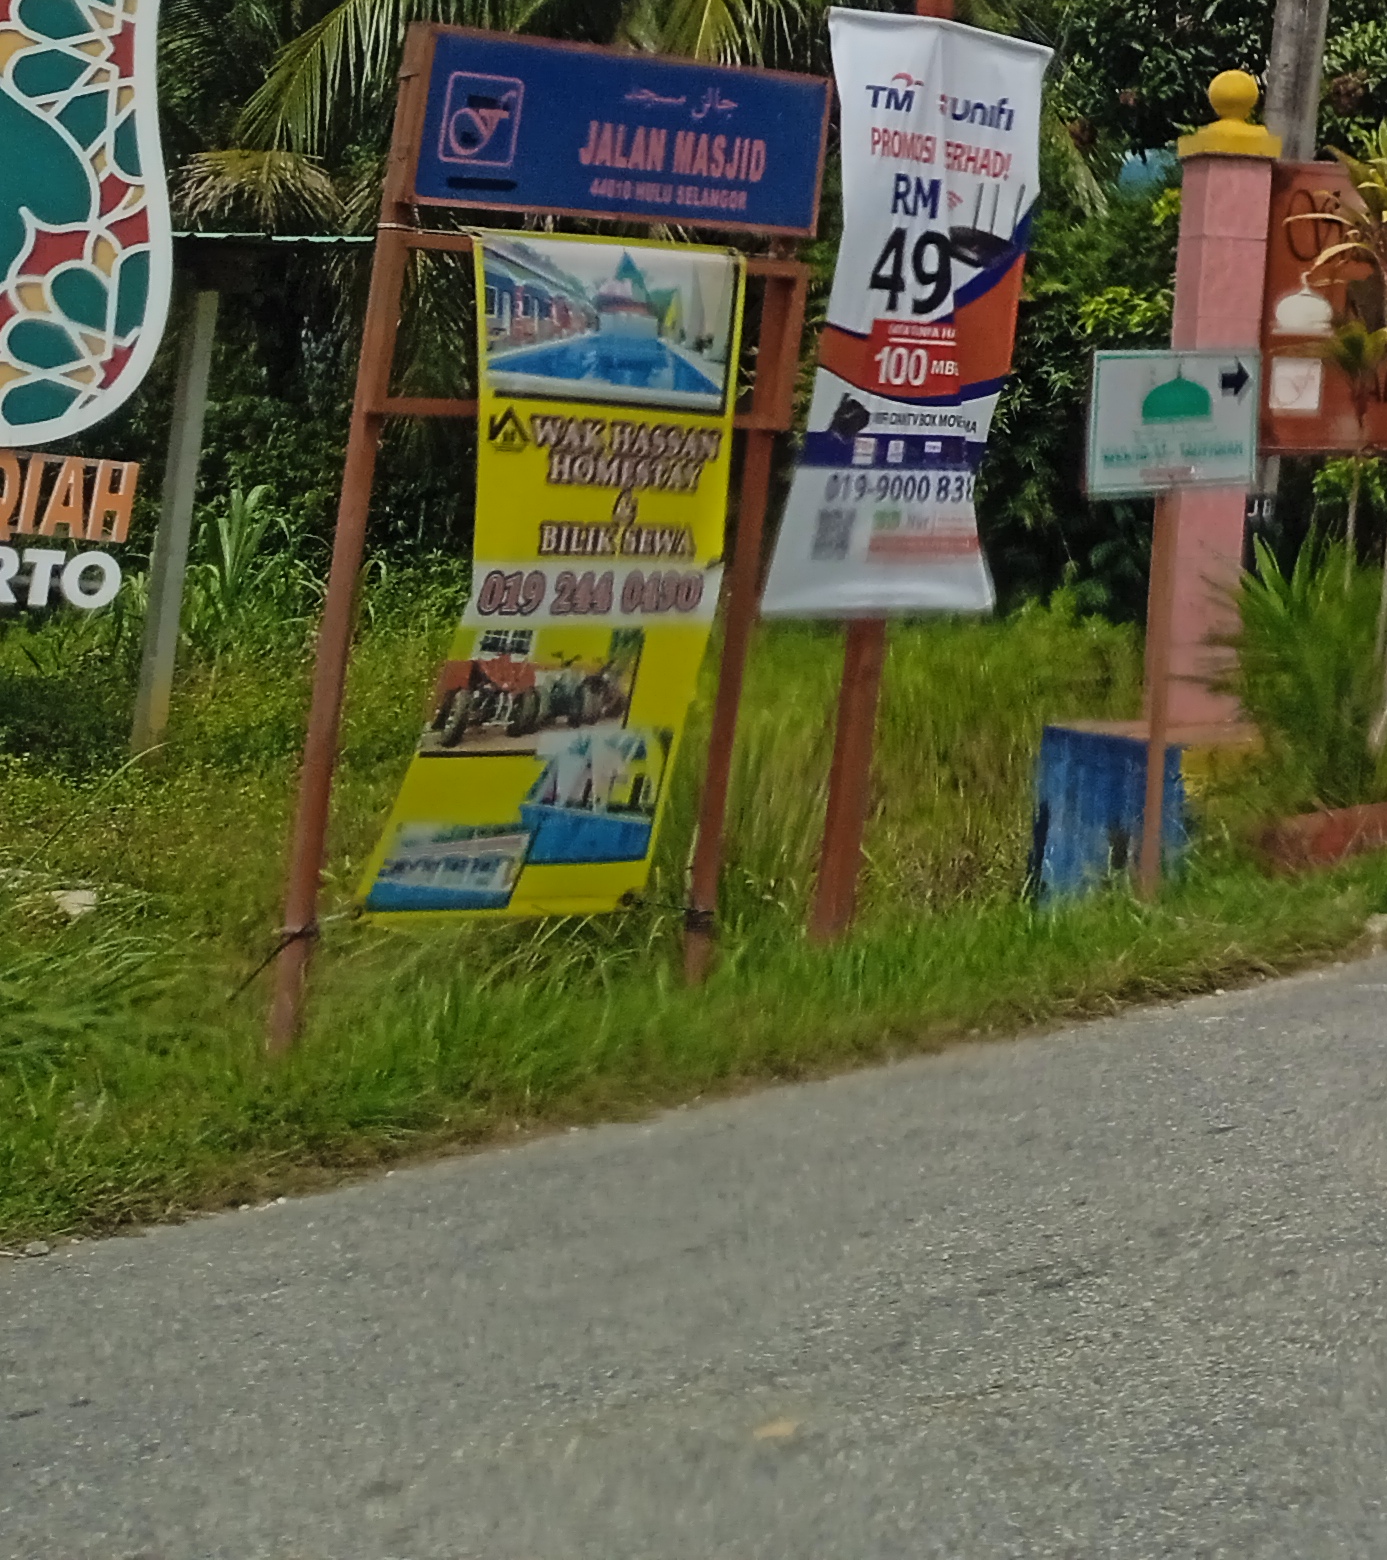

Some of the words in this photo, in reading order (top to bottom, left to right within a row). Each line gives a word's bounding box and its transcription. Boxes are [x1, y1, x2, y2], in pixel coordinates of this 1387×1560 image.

[865, 84, 915, 112] TM
[950, 97, 1016, 131] unifi
[578, 120, 668, 171] JALAN
[672, 130, 767, 183] MASJID
[870, 126, 937, 164] PROMOSI
[944, 140, 1013, 180] ERHAD!
[890, 173, 943, 219] RM
[868, 226, 953, 315] 49
[874, 345, 928, 387] 100
[930, 359, 960, 377] MB
[530, 414, 606, 450] WAK
[609, 421, 722, 461] HASSAN
[547, 450, 705, 493] HOMESTAY
[825, 472, 931, 504] 019-9000
[539, 521, 619, 556] BILIK
[620, 523, 697, 559] SEWA
[477, 569, 547, 615] 019
[550, 570, 614, 615] 244
